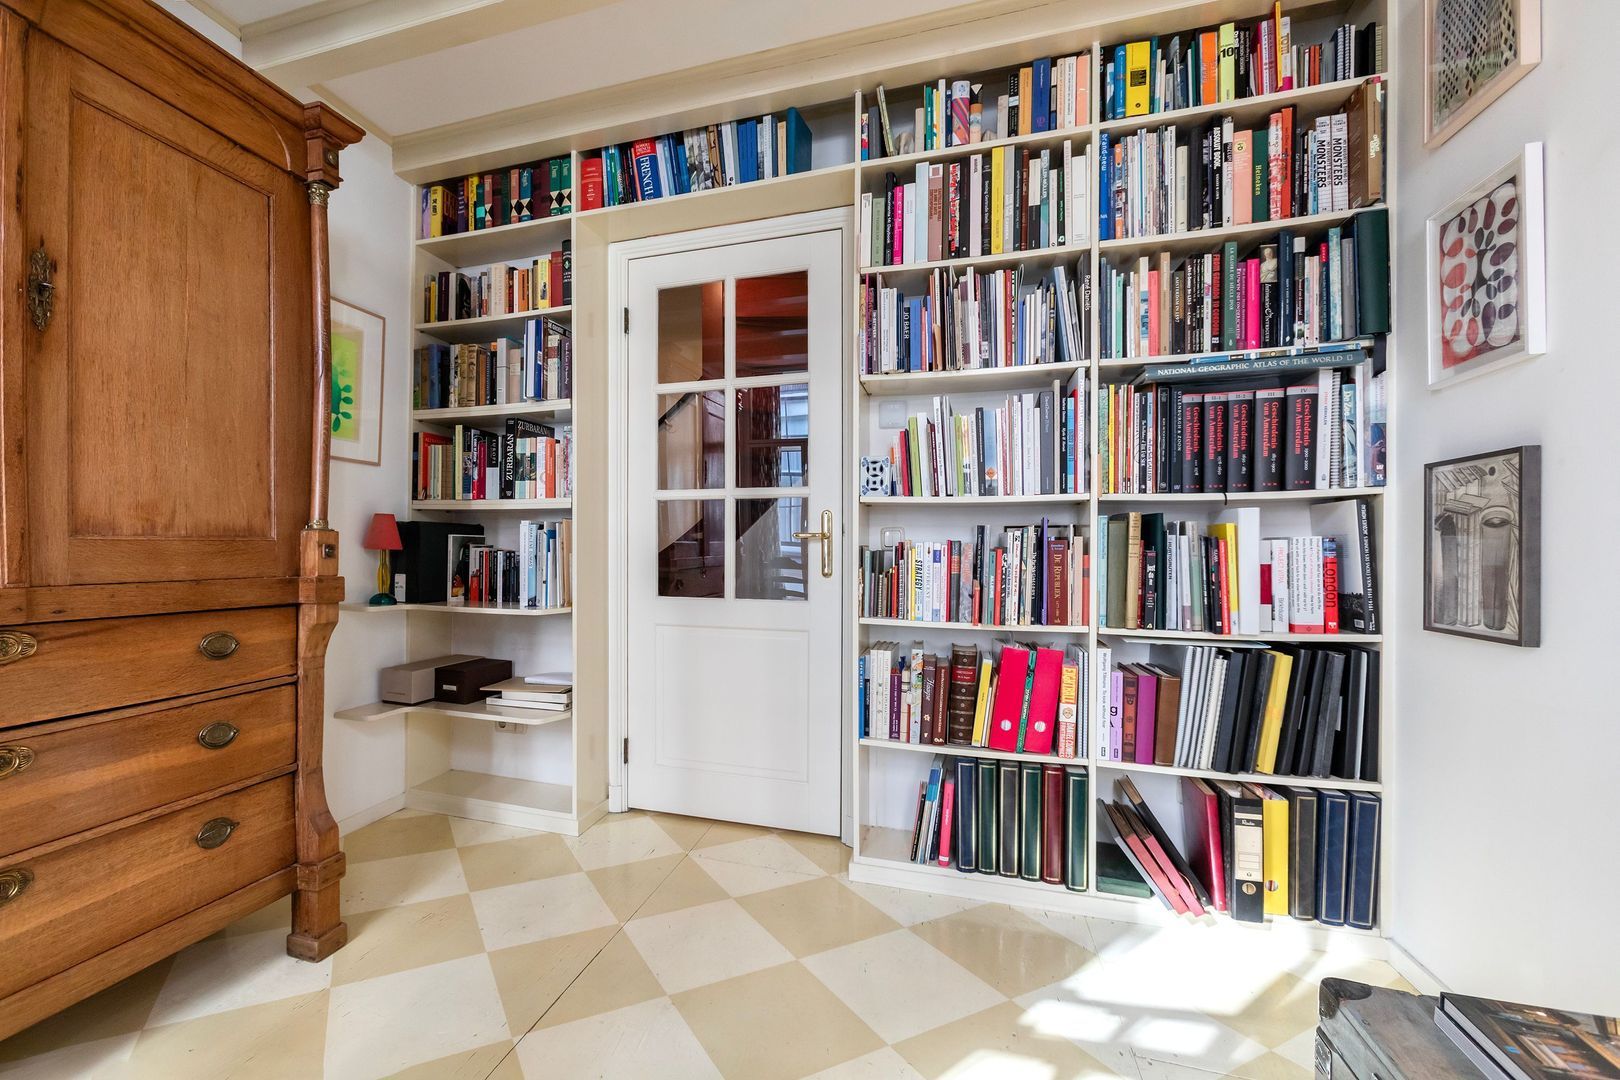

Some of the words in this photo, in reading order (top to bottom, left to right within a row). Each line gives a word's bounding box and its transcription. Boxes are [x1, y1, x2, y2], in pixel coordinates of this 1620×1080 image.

[1220, 47, 1234, 58] 10
[1213, 127, 1221, 151] ABSOLUT
[1213, 151, 1221, 169] BOOK.
[1317, 139, 1327, 188] MONSTERS
[1332, 137, 1343, 186] MONSTERS
[640, 157, 654, 195] FRENCH
[1212, 254, 1220, 272] FROM
[1212, 272, 1220, 300] GRANADA
[903, 311, 910, 320] JO
[1212, 308, 1220, 336] CORDOBA
[1157, 367, 1198, 376] NATIONAL
[1197, 362, 1250, 373] GEOGRAPHIC
[1252, 360, 1278, 369] ATLAS
[1279, 358, 1289, 367] OF
[1292, 357, 1309, 366] THE
[1311, 355, 1344, 365] WORLD
[1208, 405, 1216, 419] van
[1232, 404, 1240, 417] van
[1262, 401, 1270, 416] van
[1208, 420, 1216, 460] Amsterdam
[1216, 405, 1224, 452] Geschiedenis
[1232, 418, 1240, 459] Amsterdam
[1262, 416, 1270, 457] Amsterdam
[1271, 401, 1279, 449] Geschiedenis
[506, 434, 515, 480] ZURBARÁN
[914, 559, 923, 591] STRATEGY
[1325, 561, 1337, 608] London
[923, 677, 934, 702] Haagse
[1063, 668, 1077, 703] EIGHTBALL
